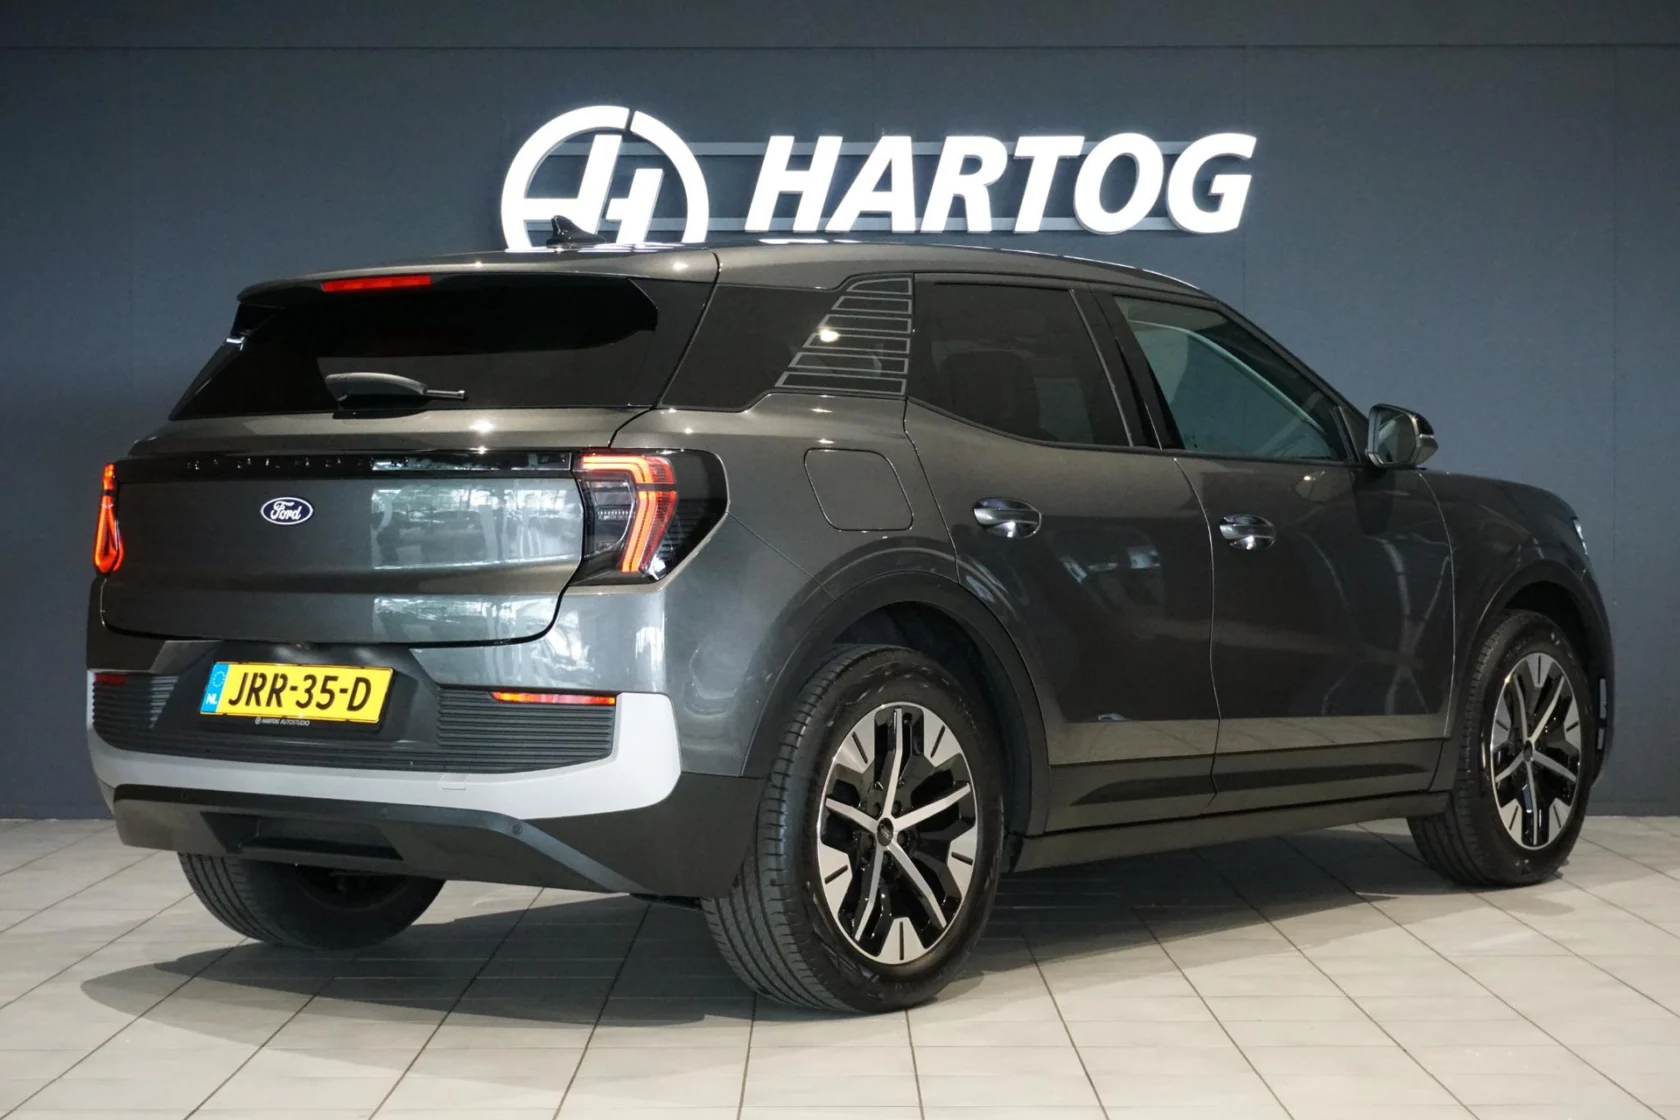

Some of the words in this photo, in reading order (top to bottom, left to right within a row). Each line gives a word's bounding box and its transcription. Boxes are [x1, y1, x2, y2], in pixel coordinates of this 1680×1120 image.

[745, 132, 1257, 234] HARTOG
[270, 500, 303, 520] Ford
[205, 693, 218, 704] NL
[228, 672, 372, 712] JRR-35-D
